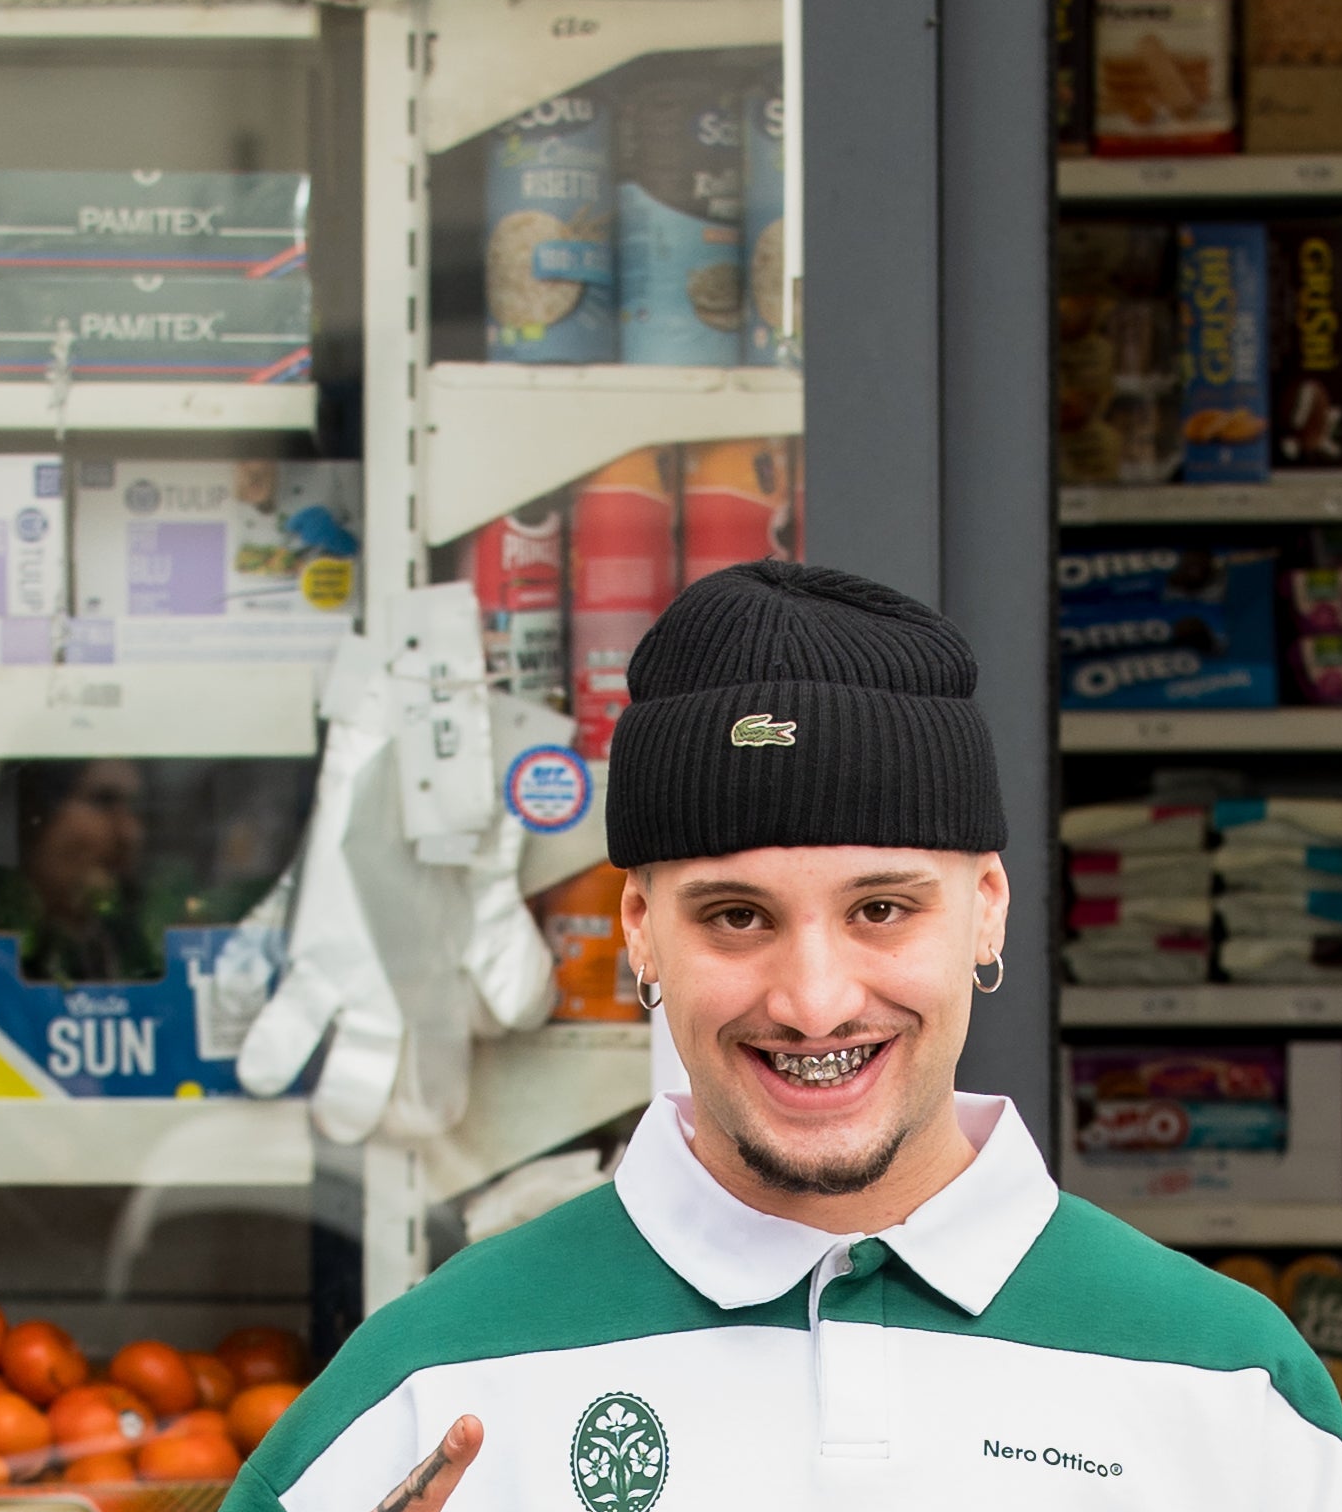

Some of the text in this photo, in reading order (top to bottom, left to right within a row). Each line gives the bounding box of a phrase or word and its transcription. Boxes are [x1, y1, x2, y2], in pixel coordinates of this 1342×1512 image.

[77, 207, 216, 236] PAMITEX
[80, 312, 216, 342] PAMITEX
[164, 487, 228, 509] TULIP
[1072, 651, 1200, 698] OREO
[47, 1017, 157, 1078] SUN
[983, 1439, 1037, 1462] Nero
